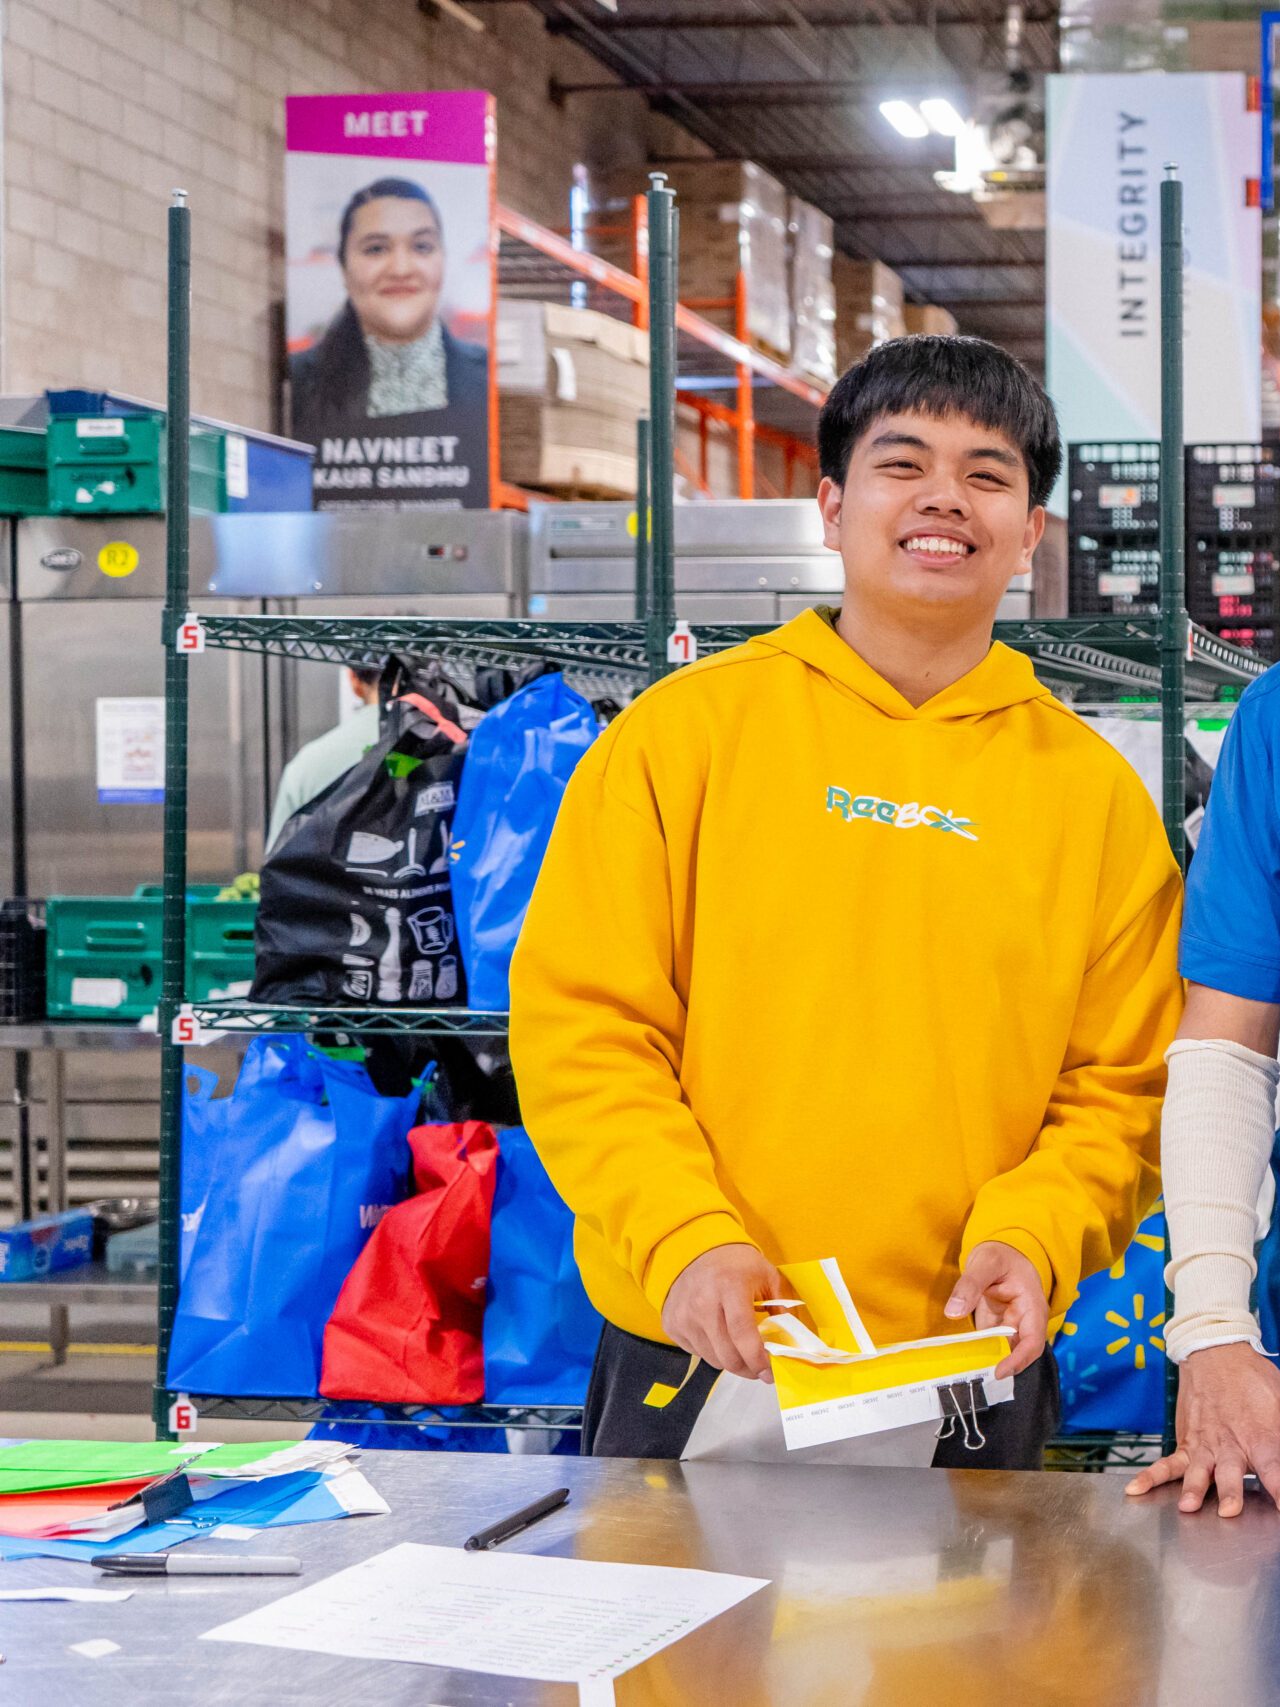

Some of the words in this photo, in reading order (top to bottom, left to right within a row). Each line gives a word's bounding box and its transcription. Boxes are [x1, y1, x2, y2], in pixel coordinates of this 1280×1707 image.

[343, 110, 429, 137] MEET
[1117, 111, 1148, 338] INTEGRITY
[322, 436, 460, 463] NAVNEET
[313, 467, 373, 488] KAUR
[376, 466, 470, 488] SANDHU
[183, 625, 199, 649] 5
[674, 634, 689, 660] 7
[178, 1017, 194, 1040] 5
[176, 1406, 190, 1430] 6
